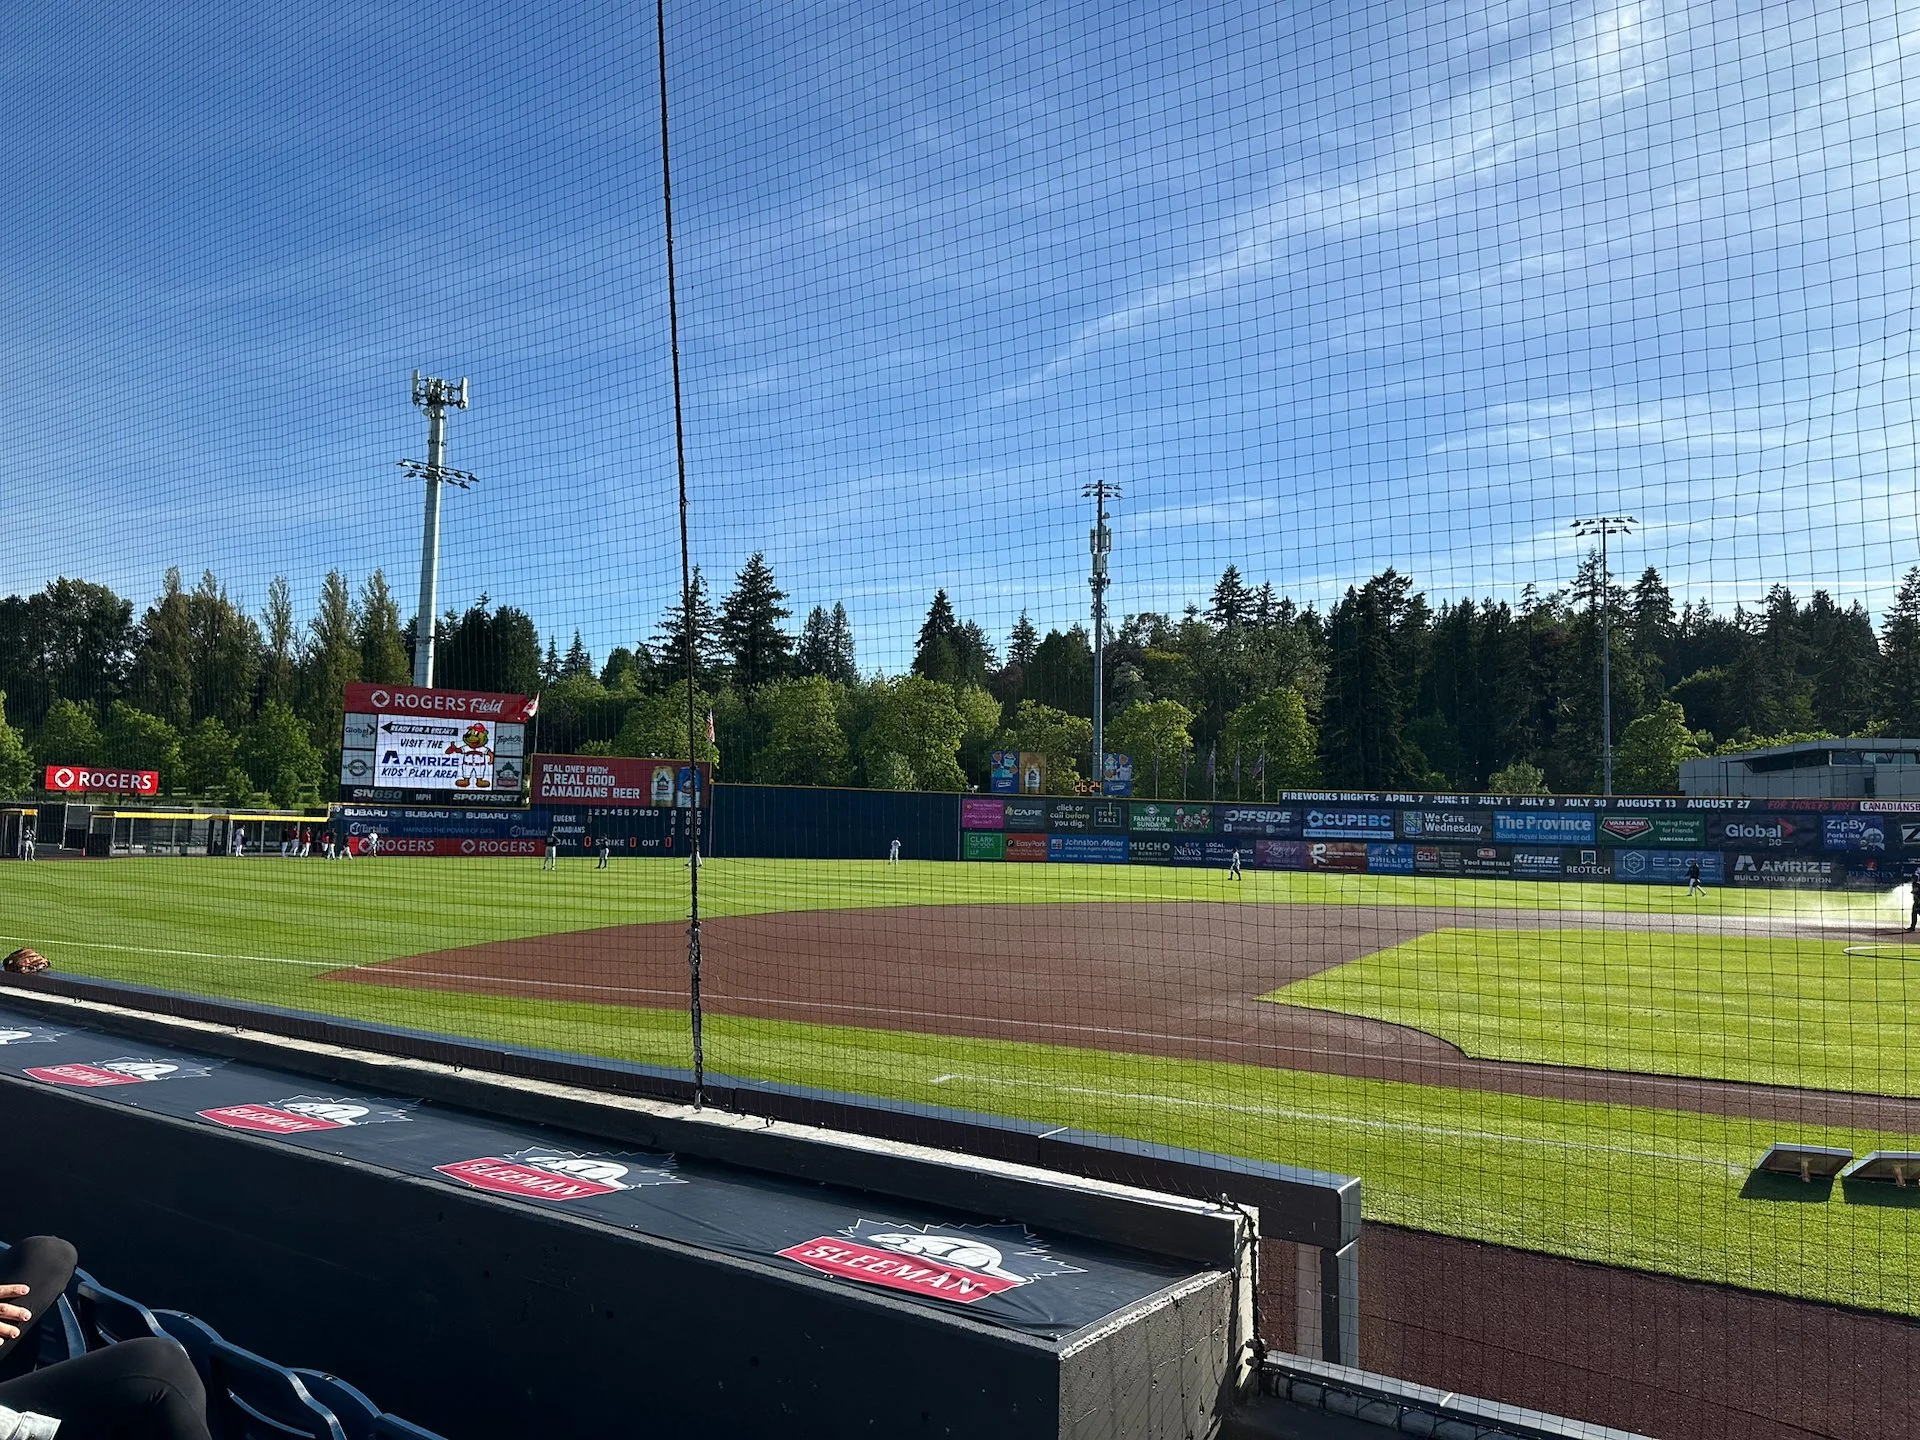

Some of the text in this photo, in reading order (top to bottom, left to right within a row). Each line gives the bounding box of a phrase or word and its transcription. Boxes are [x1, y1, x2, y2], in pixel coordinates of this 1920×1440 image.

[394, 693, 504, 714] ROGERS Field
[400, 739, 444, 749] VISIT THE
[403, 756, 459, 767] AMRIZE
[381, 767, 407, 778] KIDS'
[408, 768, 433, 778] PLAY
[433, 770, 458, 779] AREA
[543, 764, 609, 775] REAL ONES KNOW
[78, 771, 152, 790] ROGERS
[542, 774, 616, 787] A REAL GOOD
[415, 793, 432, 802] MPH
[452, 793, 520, 803] SPORTSNET
[541, 786, 640, 800] CANADIANS BEER
[1282, 792, 1338, 802] FIREWORKS
[1340, 793, 1380, 802] NIGHTS:
[1385, 794, 1416, 803] APRIL
[1432, 796, 1458, 805] JUNE
[1477, 797, 1503, 805] JULY
[1520, 798, 1544, 806] JULY
[1564, 799, 1590, 807] JULY
[1593, 800, 1607, 808] 30
[1617, 800, 1661, 808] AUGUST
[1664, 800, 1677, 808] 13
[1687, 800, 1733, 809] AUGUST
[1737, 801, 1751, 809] 27
[1767, 801, 1787, 810] FOR
[1790, 801, 1830, 810] TICKETS
[1831, 802, 1858, 810] VISIT
[344, 808, 388, 818] SUBARU
[1014, 809, 1042, 817] CAPE
[1056, 804, 1073, 812] click
[405, 810, 449, 819] SUBARU
[466, 812, 509, 820] SUBARU
[553, 815, 577, 823] EUGENE
[1224, 810, 1293, 823] OFFSIDE
[1425, 813, 1465, 823] We Care
[1054, 820, 1085, 828] you dig.
[1425, 823, 1483, 836] Wednesday
[1497, 816, 1592, 832] The Province
[1826, 819, 1867, 832] ZipBy
[552, 826, 586, 834] CANADIANS
[1725, 823, 1782, 838] Global
[377, 840, 435, 853] ROGERS
[479, 841, 536, 853] ROGERS
[584, 836, 592, 848] 0
[629, 836, 637, 848] 0
[665, 836, 673, 848] 0
[1016, 840, 1047, 848] EasyPark
[1065, 839, 1100, 847] Johnston
[1129, 842, 1171, 851] MUCHO
[1174, 846, 1202, 857] NEWS
[1416, 851, 1439, 862] 604
[1368, 856, 1414, 864] PHILLIPS
[1513, 853, 1560, 864] Kirmac
[1566, 865, 1611, 875] REOTECH
[1760, 860, 1832, 874] AMRIZE
[1786, 876, 1832, 884] AMBITION
[458, 1163, 592, 1196] SLEEMAN
[802, 1245, 987, 1295] SLEEMAN
